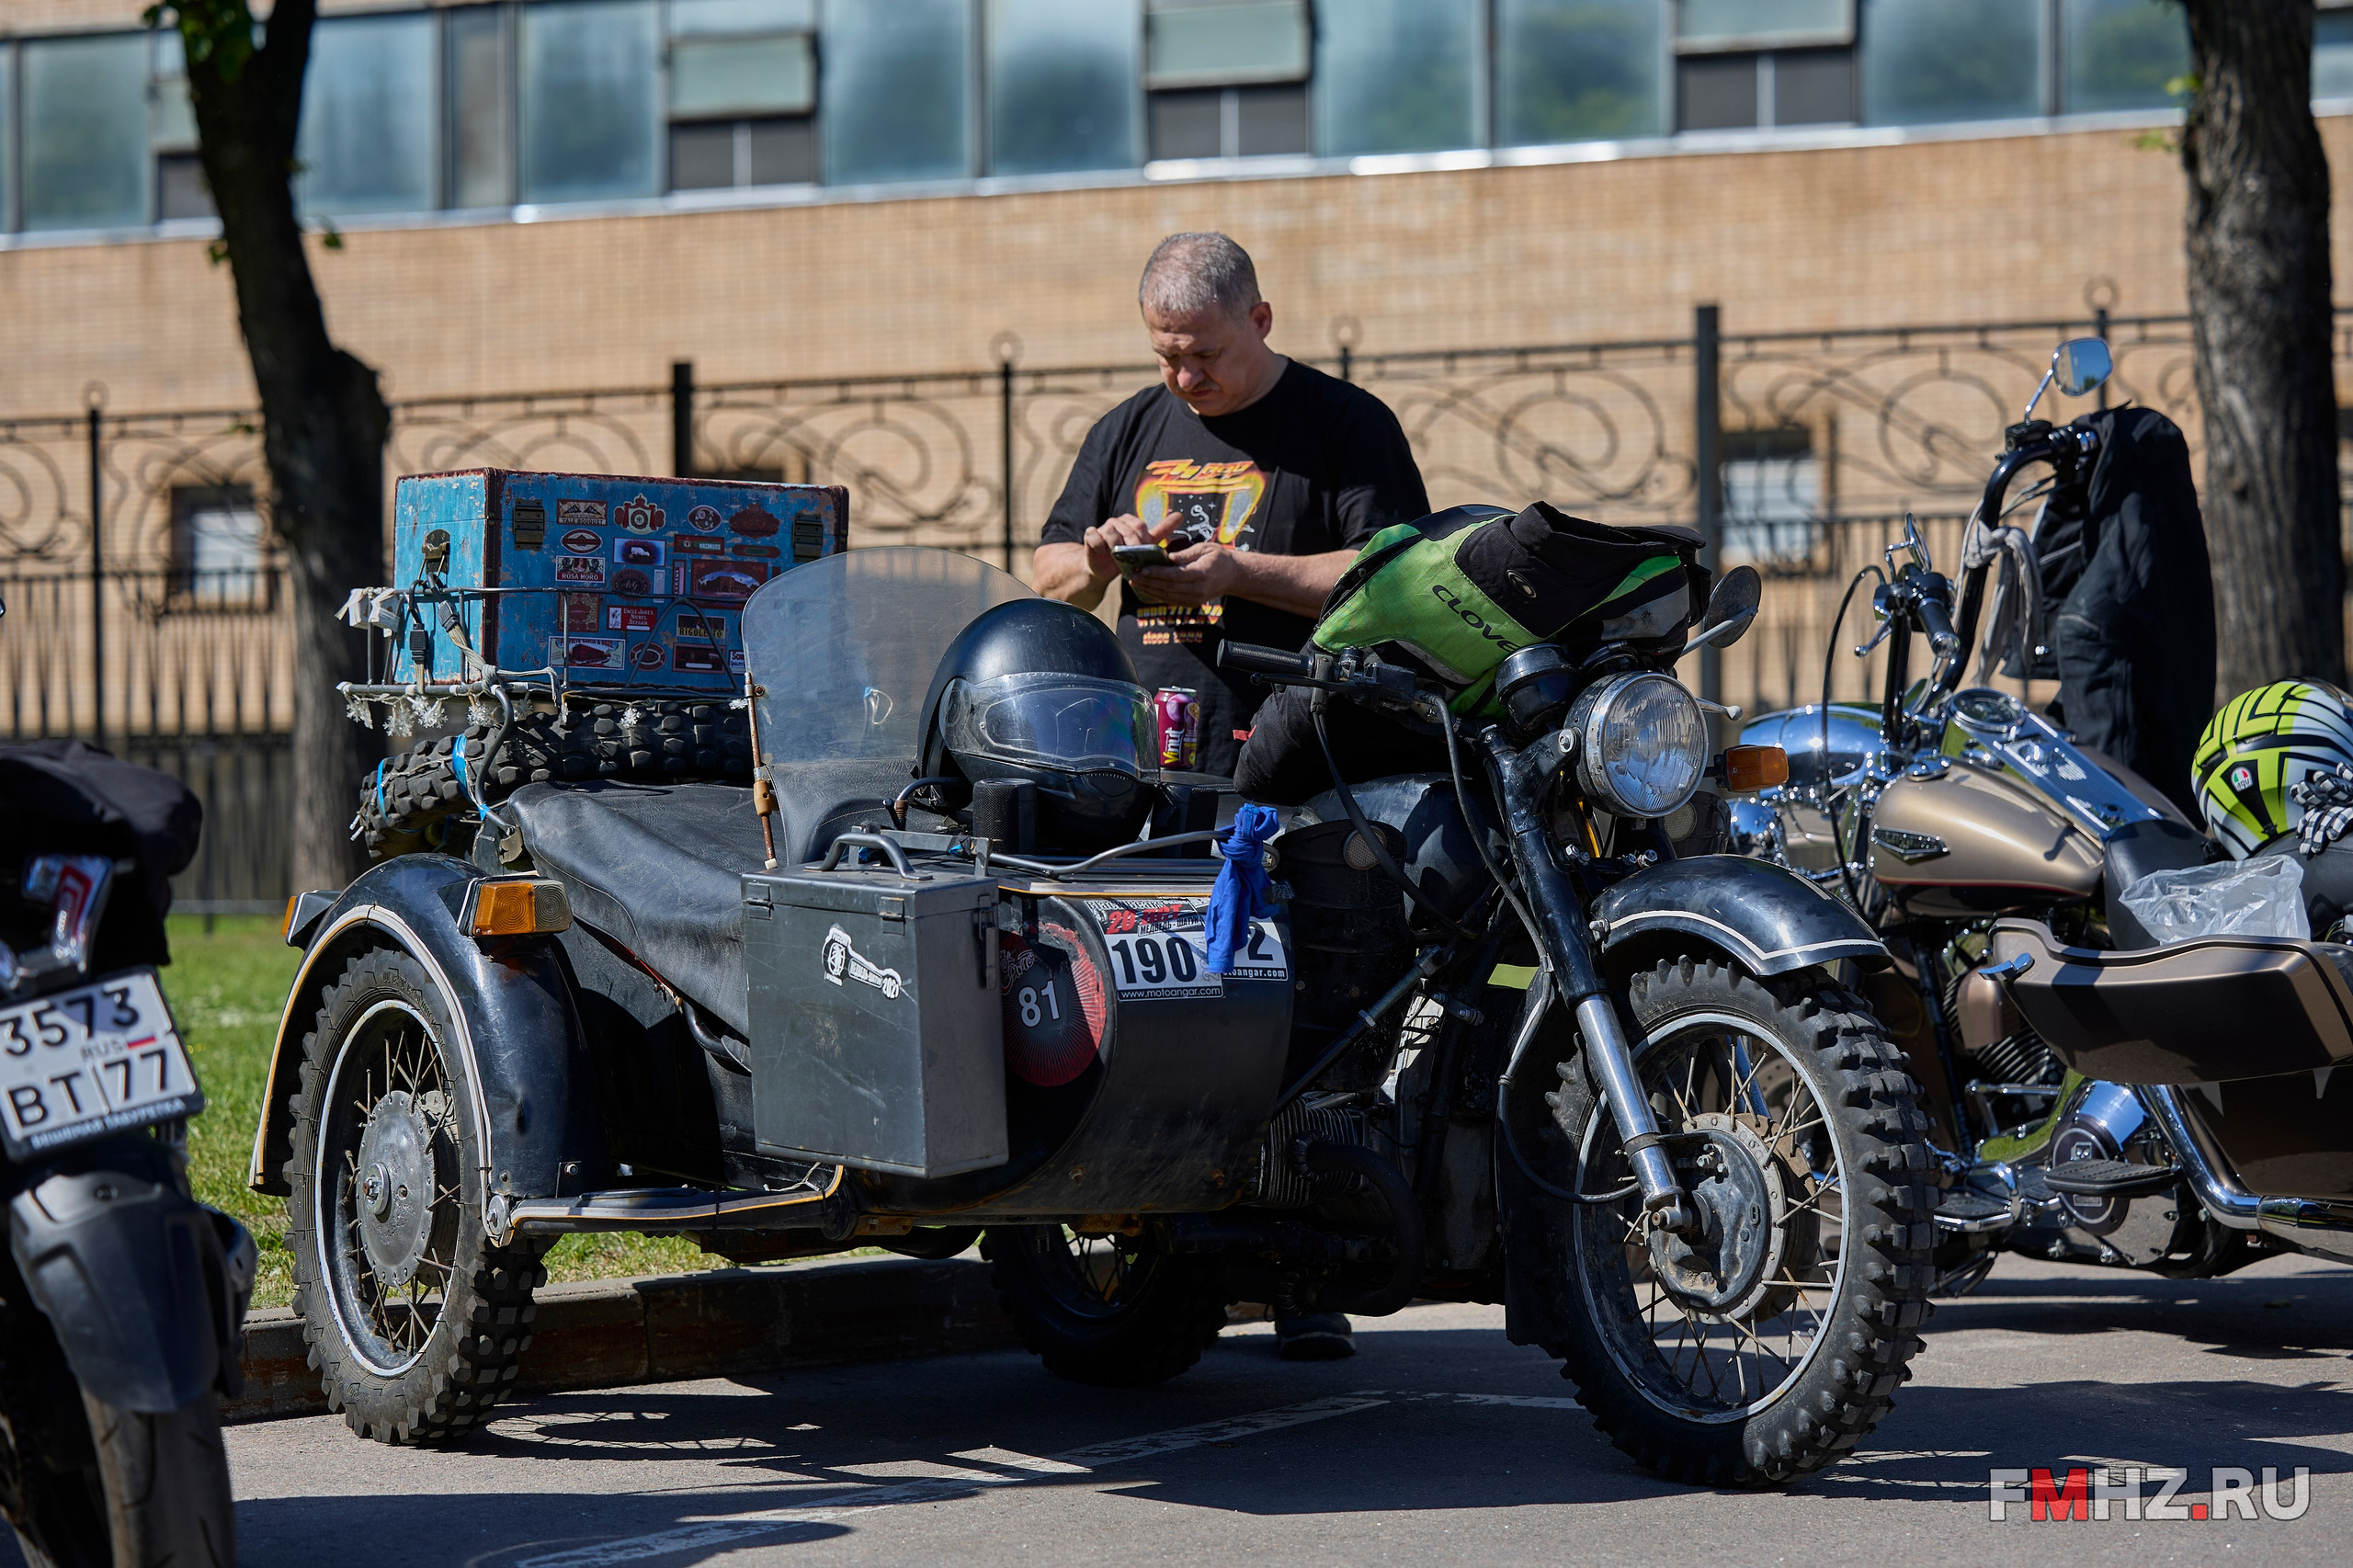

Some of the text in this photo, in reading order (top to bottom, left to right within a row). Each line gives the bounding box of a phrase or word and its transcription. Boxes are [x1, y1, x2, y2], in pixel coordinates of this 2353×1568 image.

[679, 628, 722, 638] RIGOLETO
[1432, 585, 1521, 653] CLOVE
[1163, 727, 1185, 764] Vinut
[1106, 909, 1136, 934] 20
[1140, 920, 1172, 935] МЕДВЕДЬ
[1176, 915, 1202, 927] ШАТУН
[1111, 937, 1197, 984] 190
[1018, 980, 1060, 1028] 81
[1120, 986, 1221, 1000] www.motoangar.com
[0, 987, 140, 1056] 3573
[82, 1038, 125, 1060] RUS
[104, 1049, 166, 1101] 77
